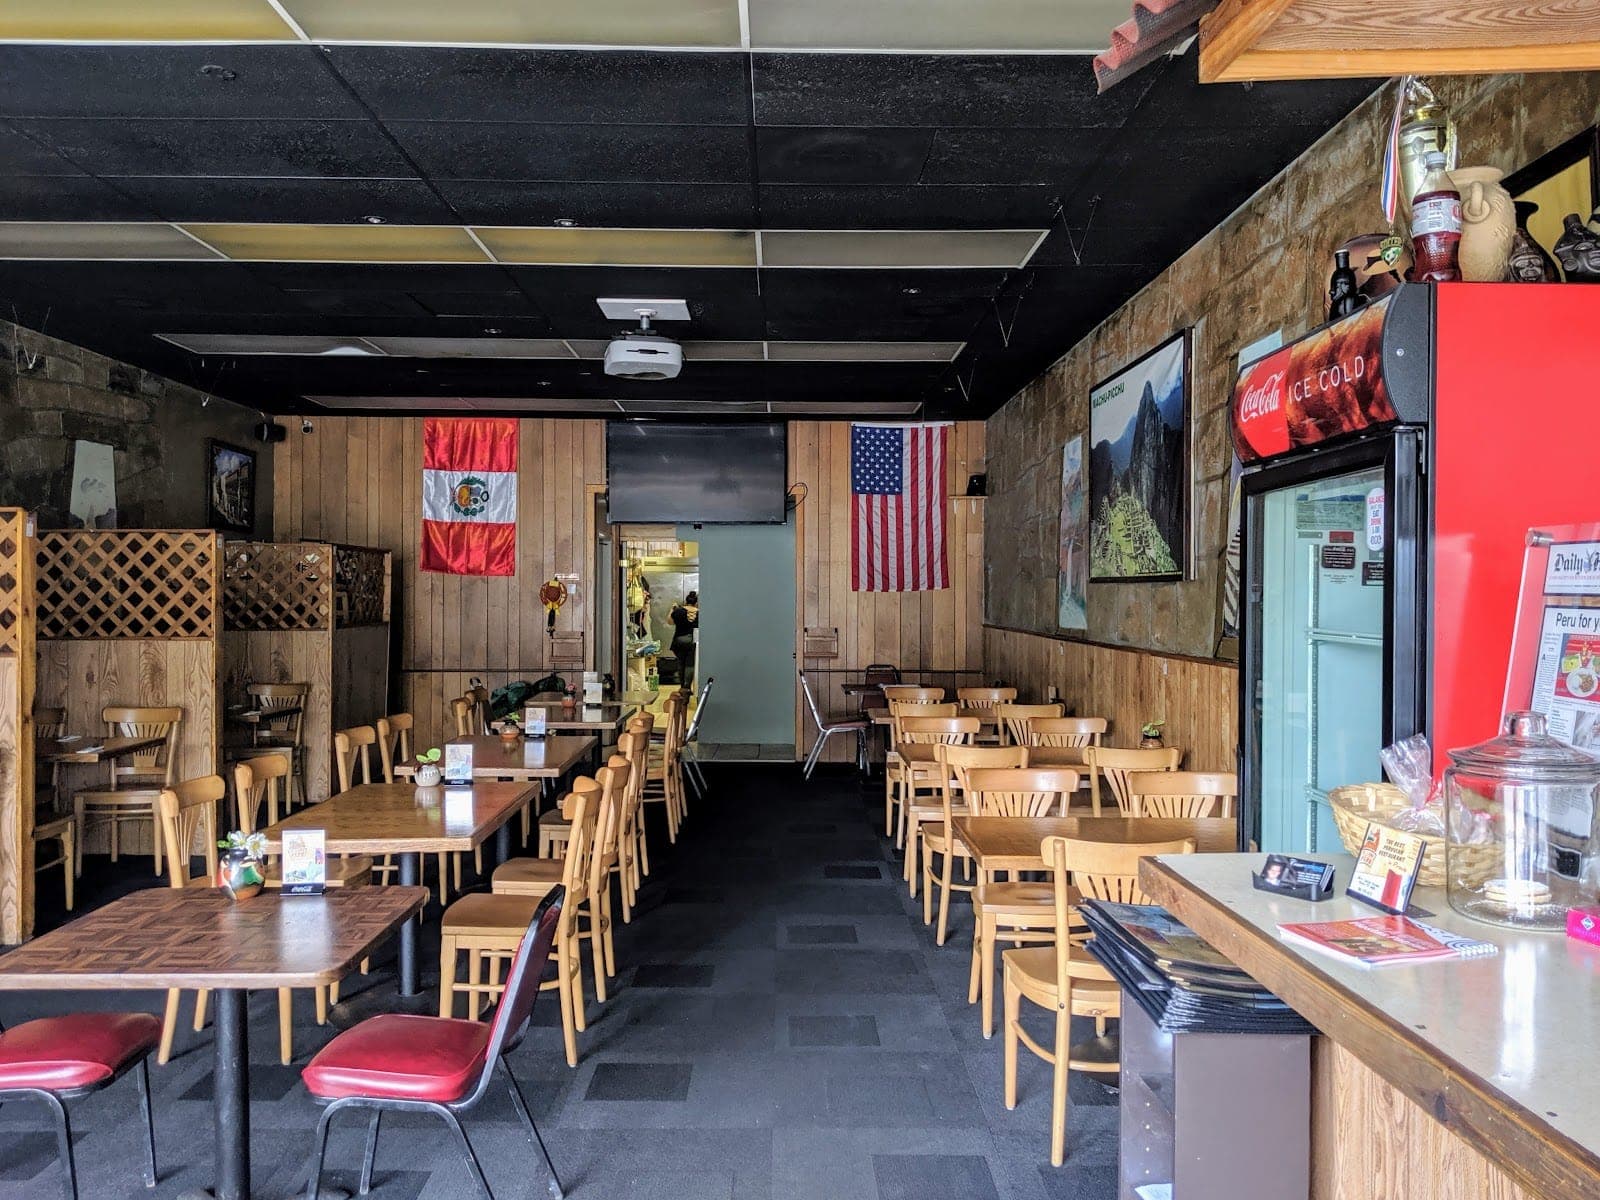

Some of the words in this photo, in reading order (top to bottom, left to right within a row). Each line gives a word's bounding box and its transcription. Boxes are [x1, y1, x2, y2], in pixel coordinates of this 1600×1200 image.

[1288, 377, 1312, 405] ICE
[1319, 355, 1364, 391] COLD
[1554, 553, 1583, 575] Daily
[1556, 612, 1576, 628] Peru
[1579, 613, 1592, 628] for
